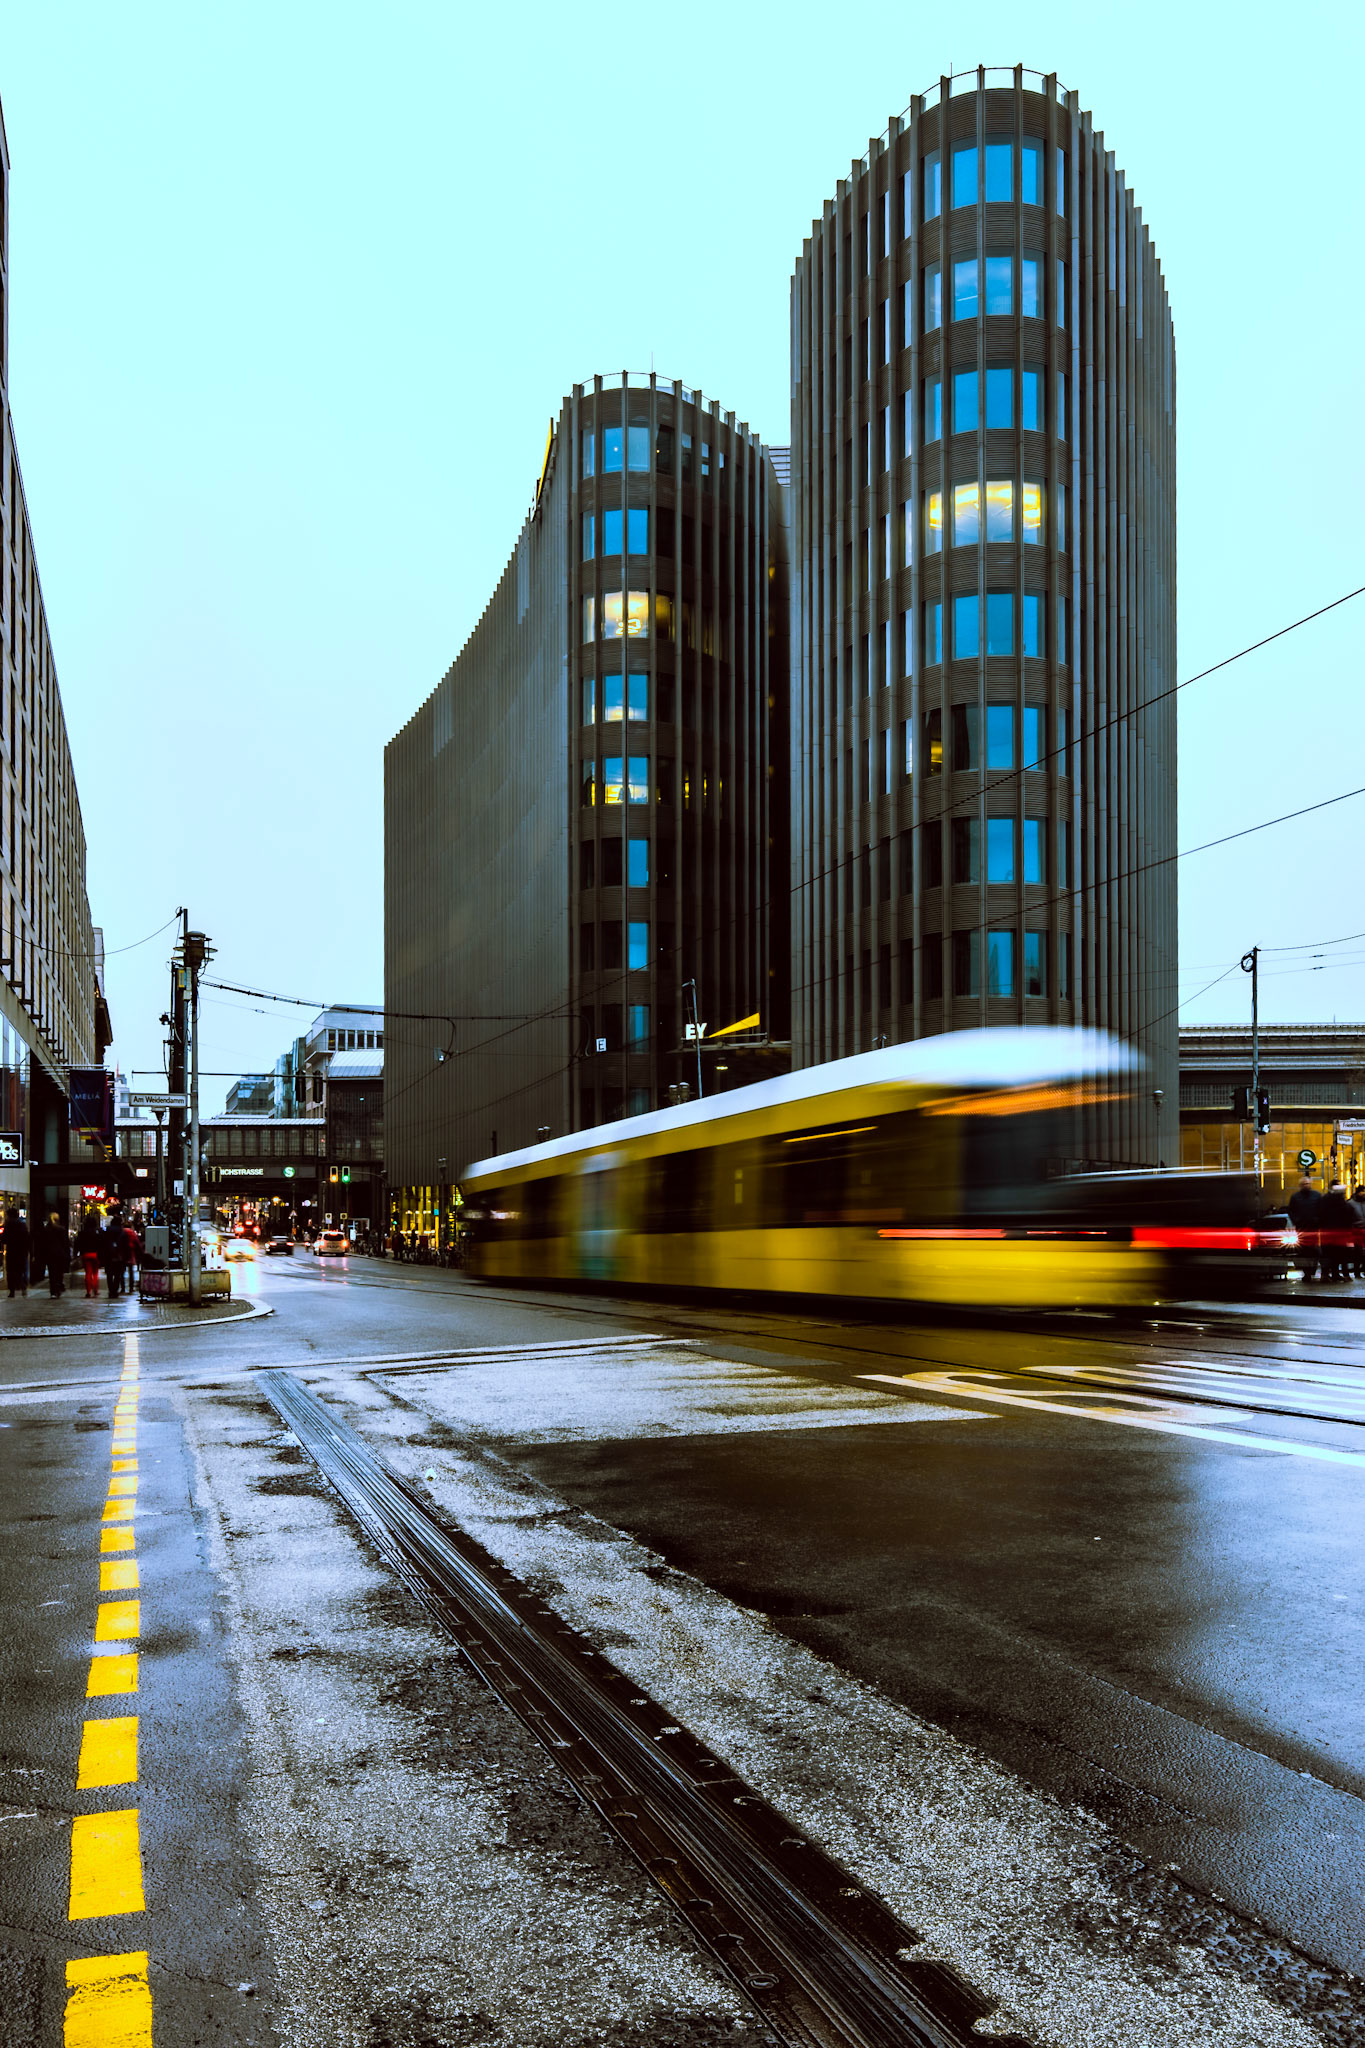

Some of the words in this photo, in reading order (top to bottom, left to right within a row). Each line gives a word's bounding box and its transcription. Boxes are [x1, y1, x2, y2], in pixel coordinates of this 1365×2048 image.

[685, 1022, 708, 1040] EY
[133, 1095, 144, 1103] Am
[145, 1096, 185, 1104] Weidendamm
[1301, 1151, 1313, 1165] S
[284, 1167, 294, 1178] S
